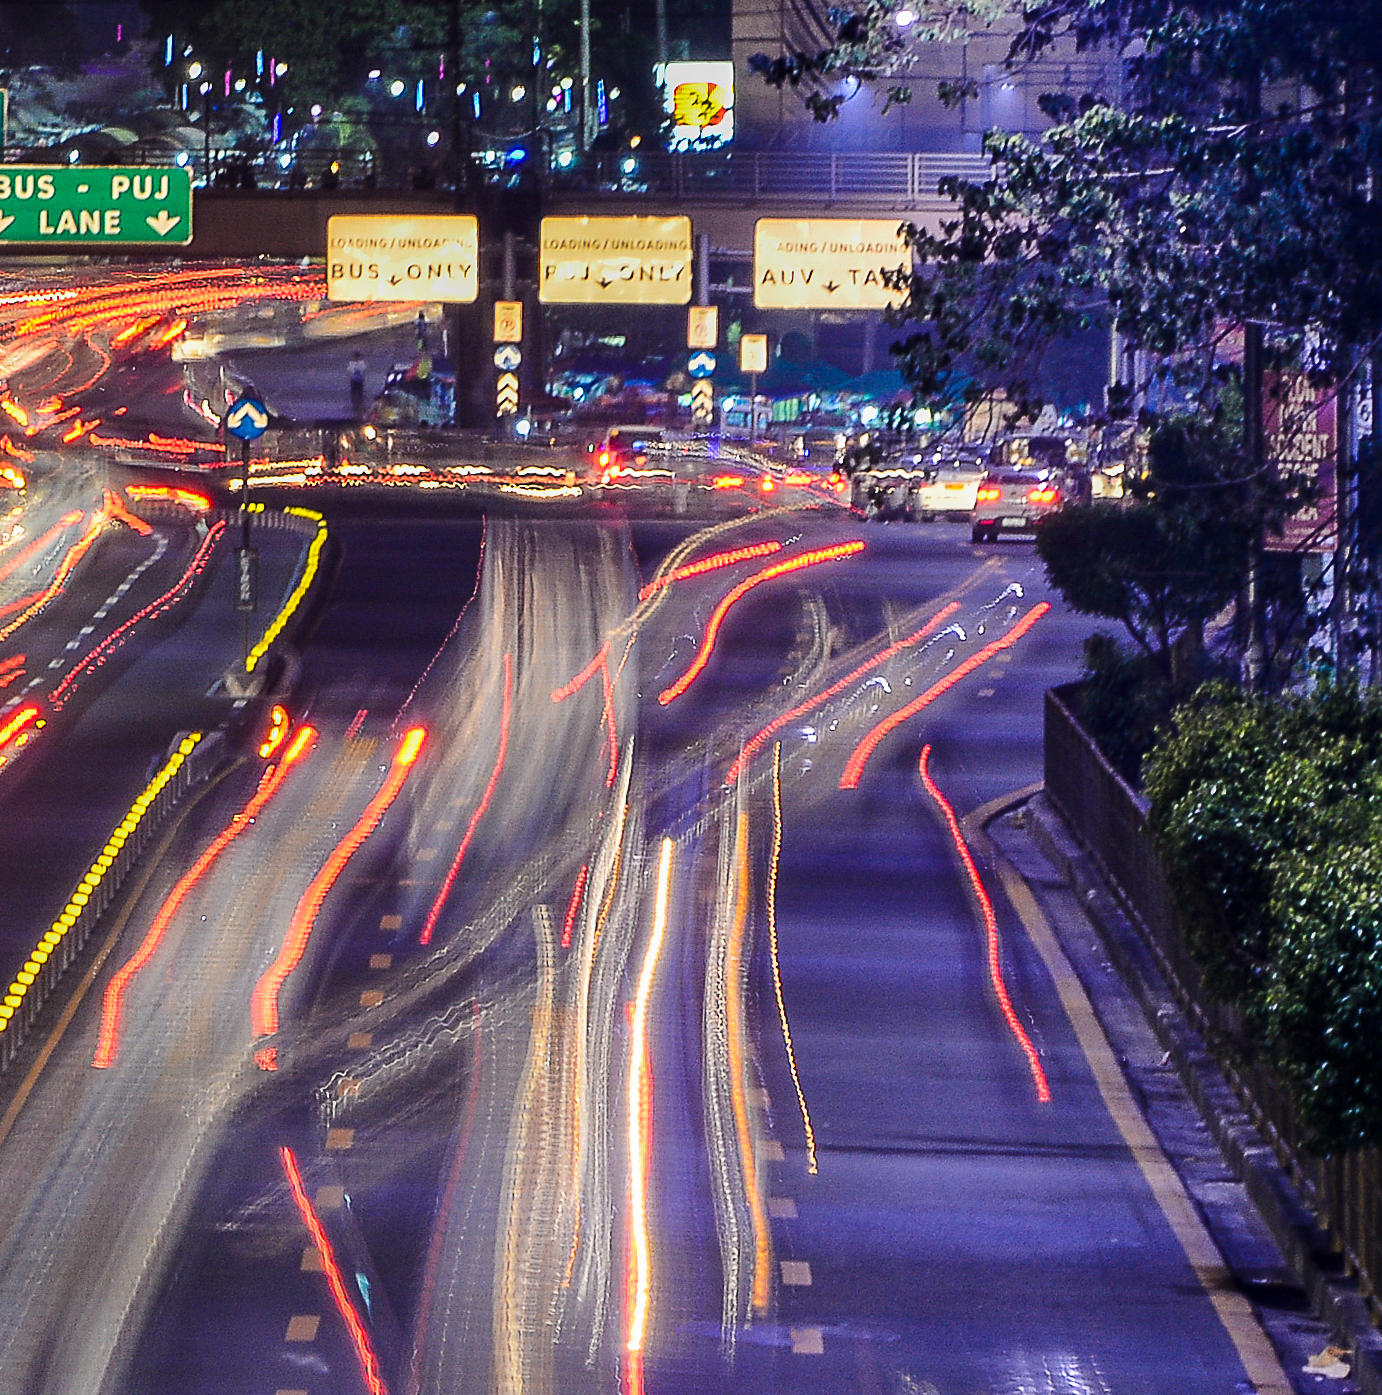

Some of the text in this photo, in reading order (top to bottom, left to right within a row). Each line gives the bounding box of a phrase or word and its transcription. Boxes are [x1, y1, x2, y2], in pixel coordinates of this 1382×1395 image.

[111, 175, 170, 200] PUJ
[39, 210, 121, 234] LANE
[331, 263, 379, 279] BUS
[407, 263, 472, 280] ONLY
[545, 265, 590, 280] PJ
[761, 269, 814, 285] AUV
